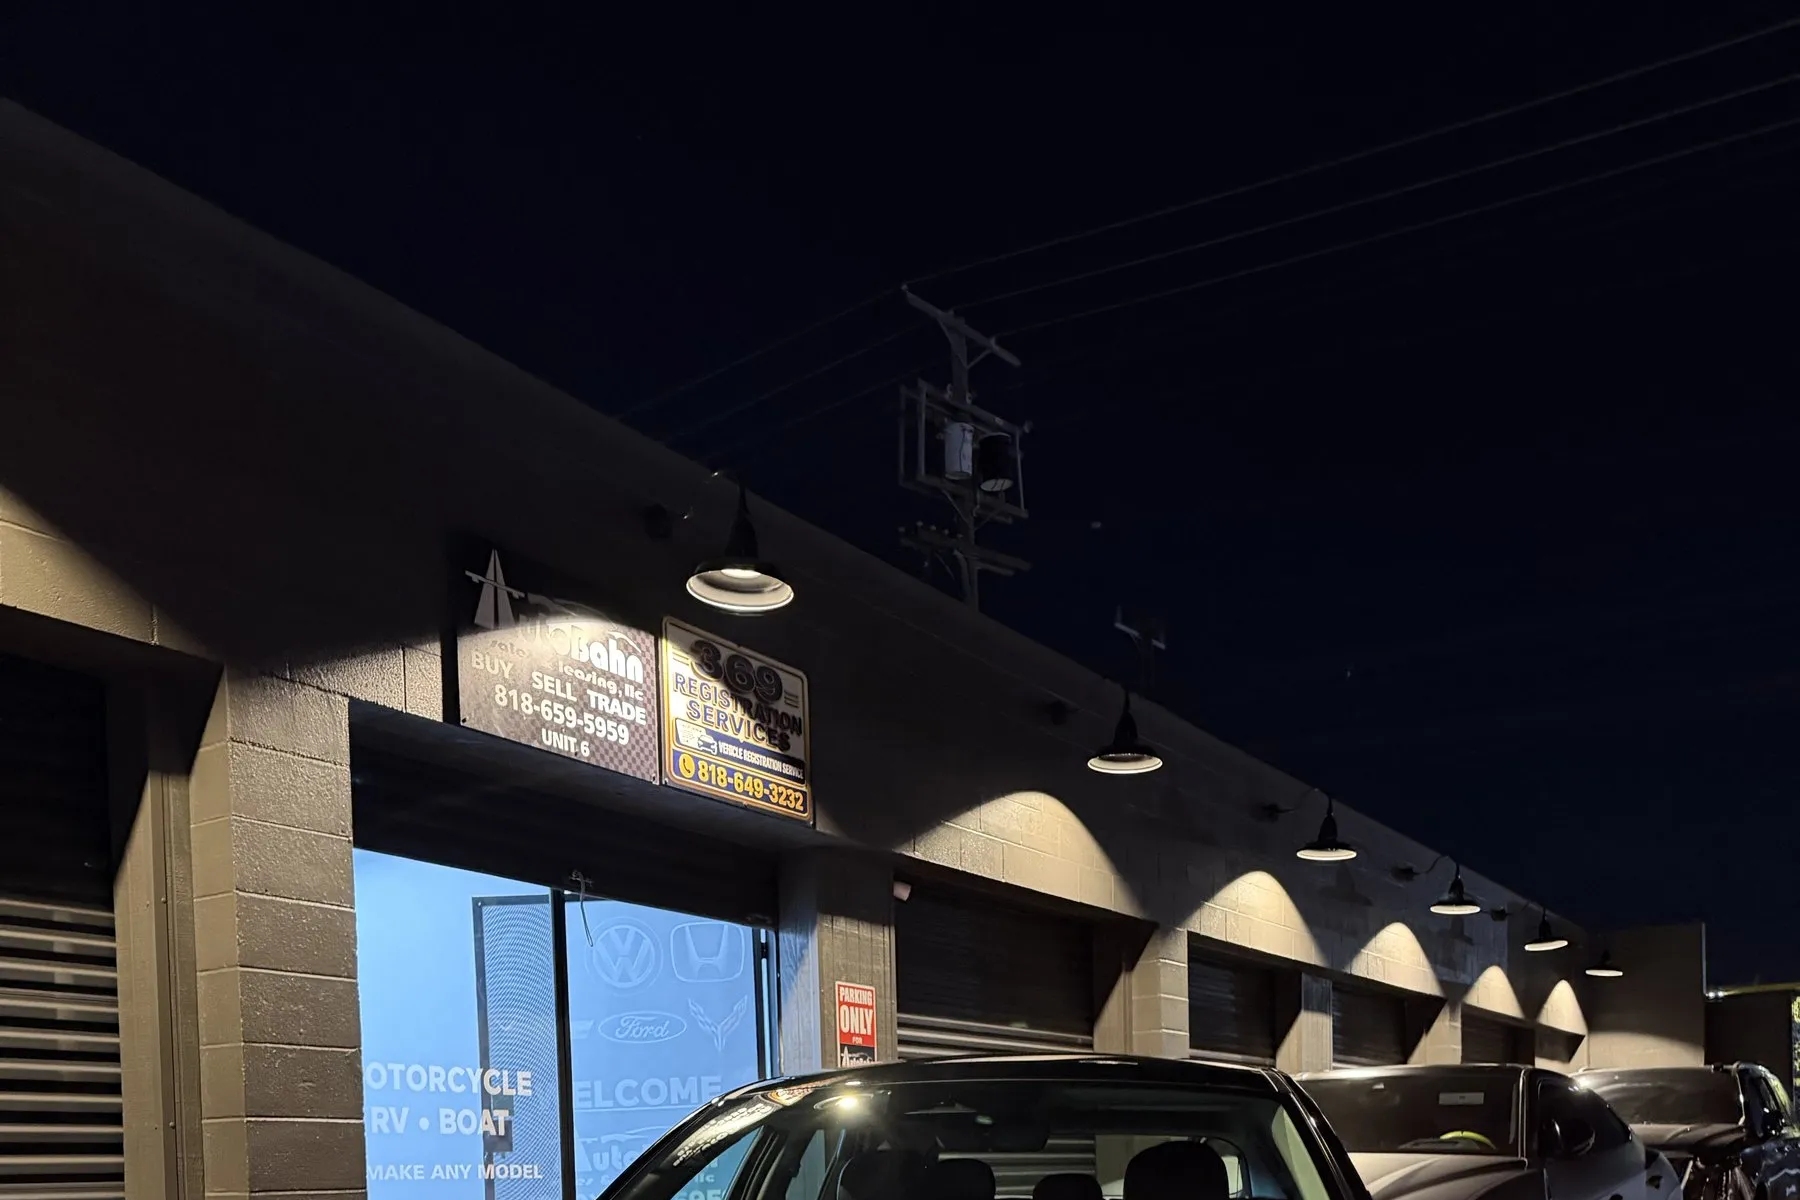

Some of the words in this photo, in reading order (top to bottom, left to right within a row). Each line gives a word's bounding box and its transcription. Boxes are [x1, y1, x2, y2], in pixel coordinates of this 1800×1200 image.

[690, 639, 783, 704] 369
[471, 651, 513, 679] BUY
[531, 671, 577, 702] SELL
[586, 689, 647, 725] TRADE
[494, 684, 629, 746] 818-659-5959
[674, 672, 803, 737] REGISTRATION
[686, 699, 791, 752] SERVICES
[541, 728, 577, 753] UNIT
[580, 741, 590, 757] 6
[718, 740, 744, 760] VEHICLE
[743, 749, 782, 773] REGISTRATION
[697, 760, 804, 811] 818-649-3232
[839, 987, 873, 1006] PARKING
[615, 1015, 670, 1038] Ford
[840, 1005, 873, 1035] ONLY
[852, 1037, 862, 1045] FOR
[365, 1062, 533, 1096] OTORCYCLE
[573, 1076, 723, 1108] ELCOME
[371, 1106, 409, 1134] RV
[439, 1108, 509, 1136] BOAT
[366, 1164, 424, 1181] MAKE
[430, 1164, 472, 1180] ANY
[478, 1164, 543, 1180] MODEL
